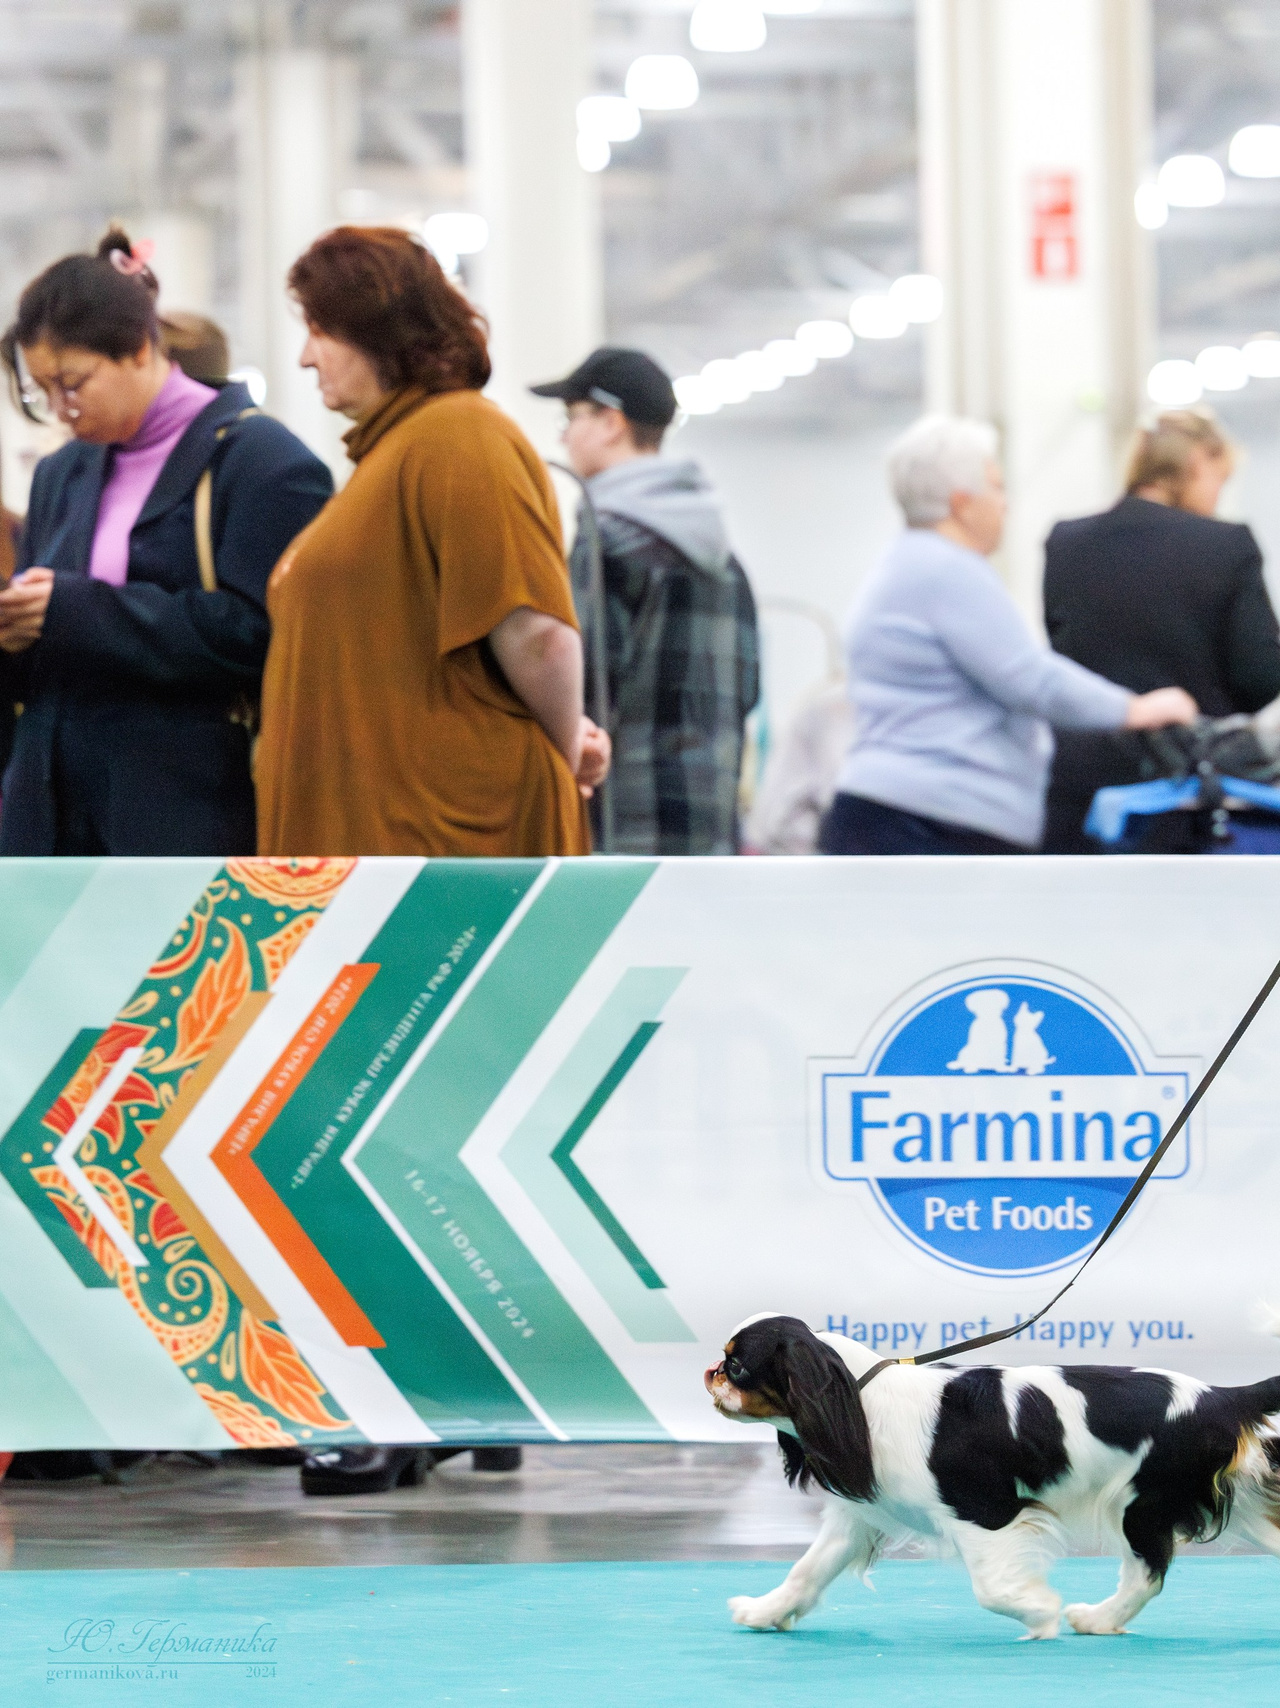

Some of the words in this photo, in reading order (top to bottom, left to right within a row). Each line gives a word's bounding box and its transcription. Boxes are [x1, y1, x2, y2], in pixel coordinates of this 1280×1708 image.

[850, 1090, 1161, 1163] Farmina
[924, 1197, 981, 1231] Pet
[992, 1196, 1094, 1231] Foods
[441, 1220, 502, 1294] НОЯБРЯ
[826, 1314, 927, 1350] Happy
[1014, 1312, 1114, 1347] Happy
[1127, 1318, 1193, 1351] you.
